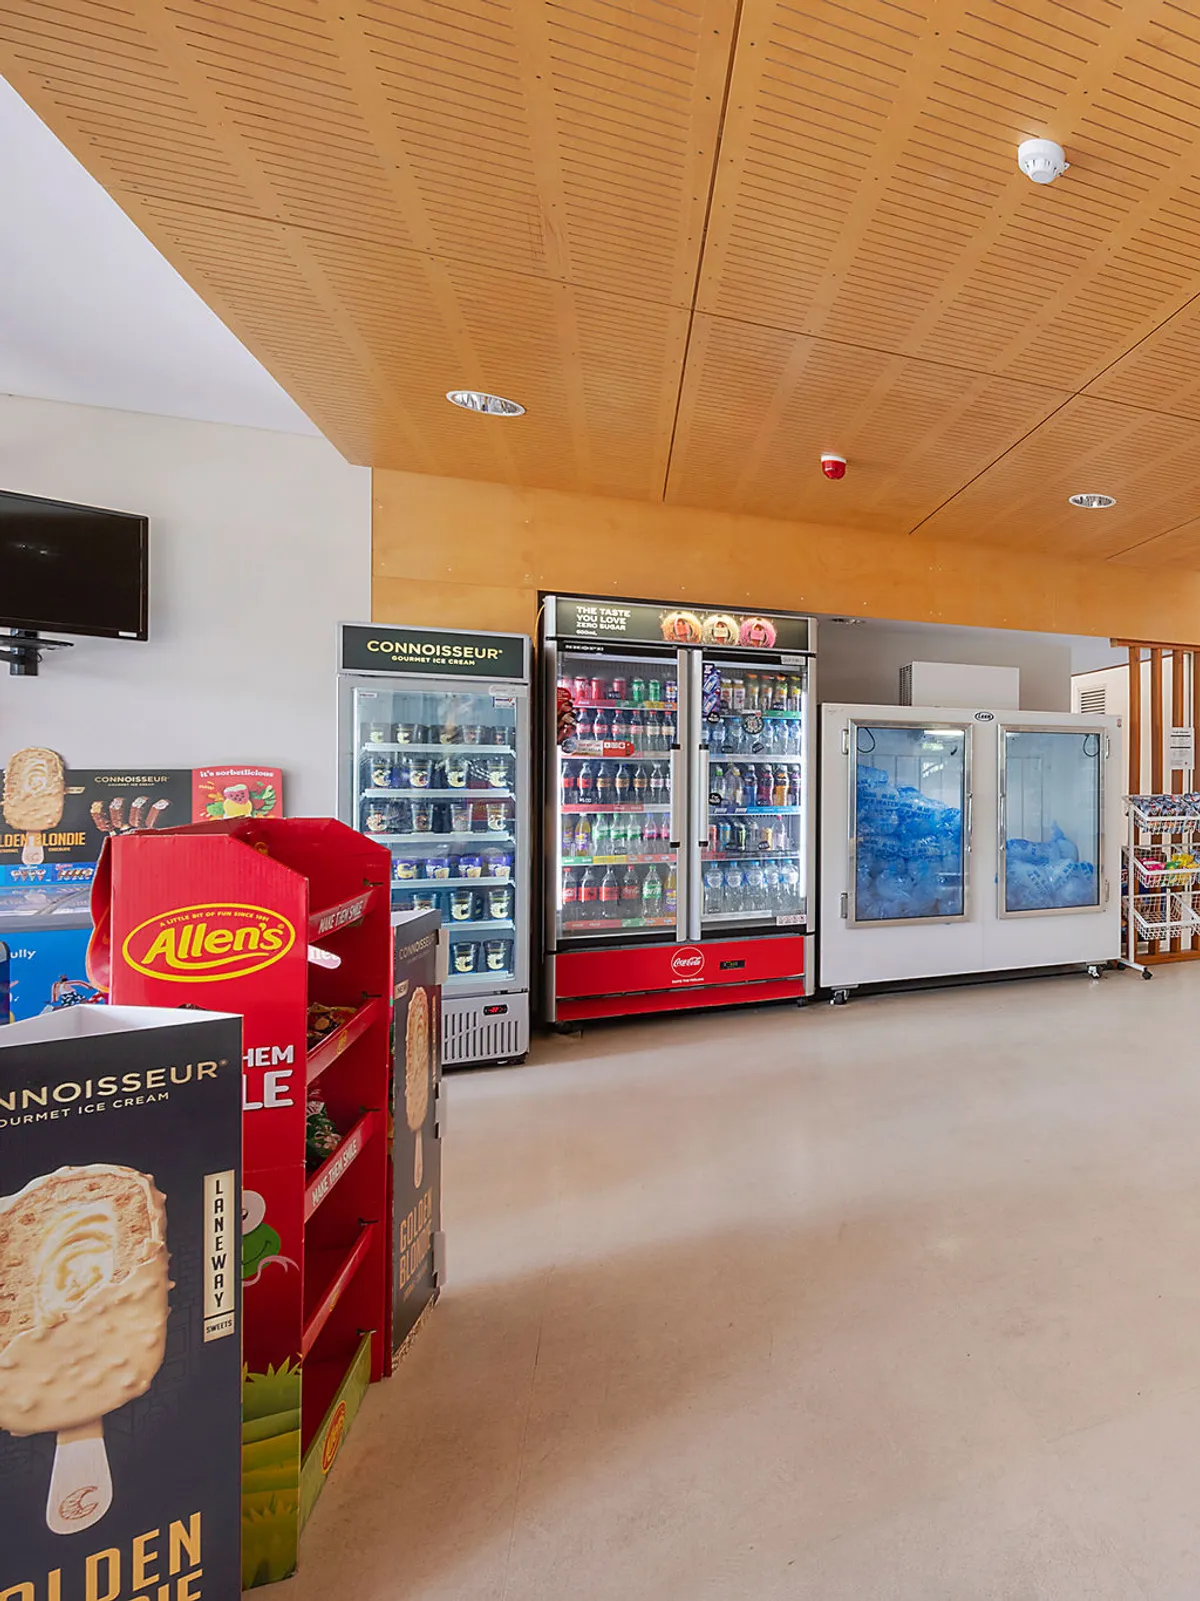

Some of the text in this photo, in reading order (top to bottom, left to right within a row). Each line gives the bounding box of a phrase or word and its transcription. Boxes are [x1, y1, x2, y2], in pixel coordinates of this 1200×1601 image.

[576, 606, 631, 617] THE TASTE
[576, 614, 627, 625] YOU LOVE
[576, 621, 597, 629] ZERO
[367, 640, 498, 659] CONNOISSEUR
[391, 655, 430, 663] GOURMET
[34, 832, 86, 847] BLONDIE
[167, 915, 190, 925] LITTLE
[141, 923, 284, 970] Allen's
[79, 1102, 106, 1115] ICE
[113, 1092, 169, 1109] CREAM
[211, 1180, 226, 1308] LANEWAY
[206, 1320, 232, 1333] SWEETS
